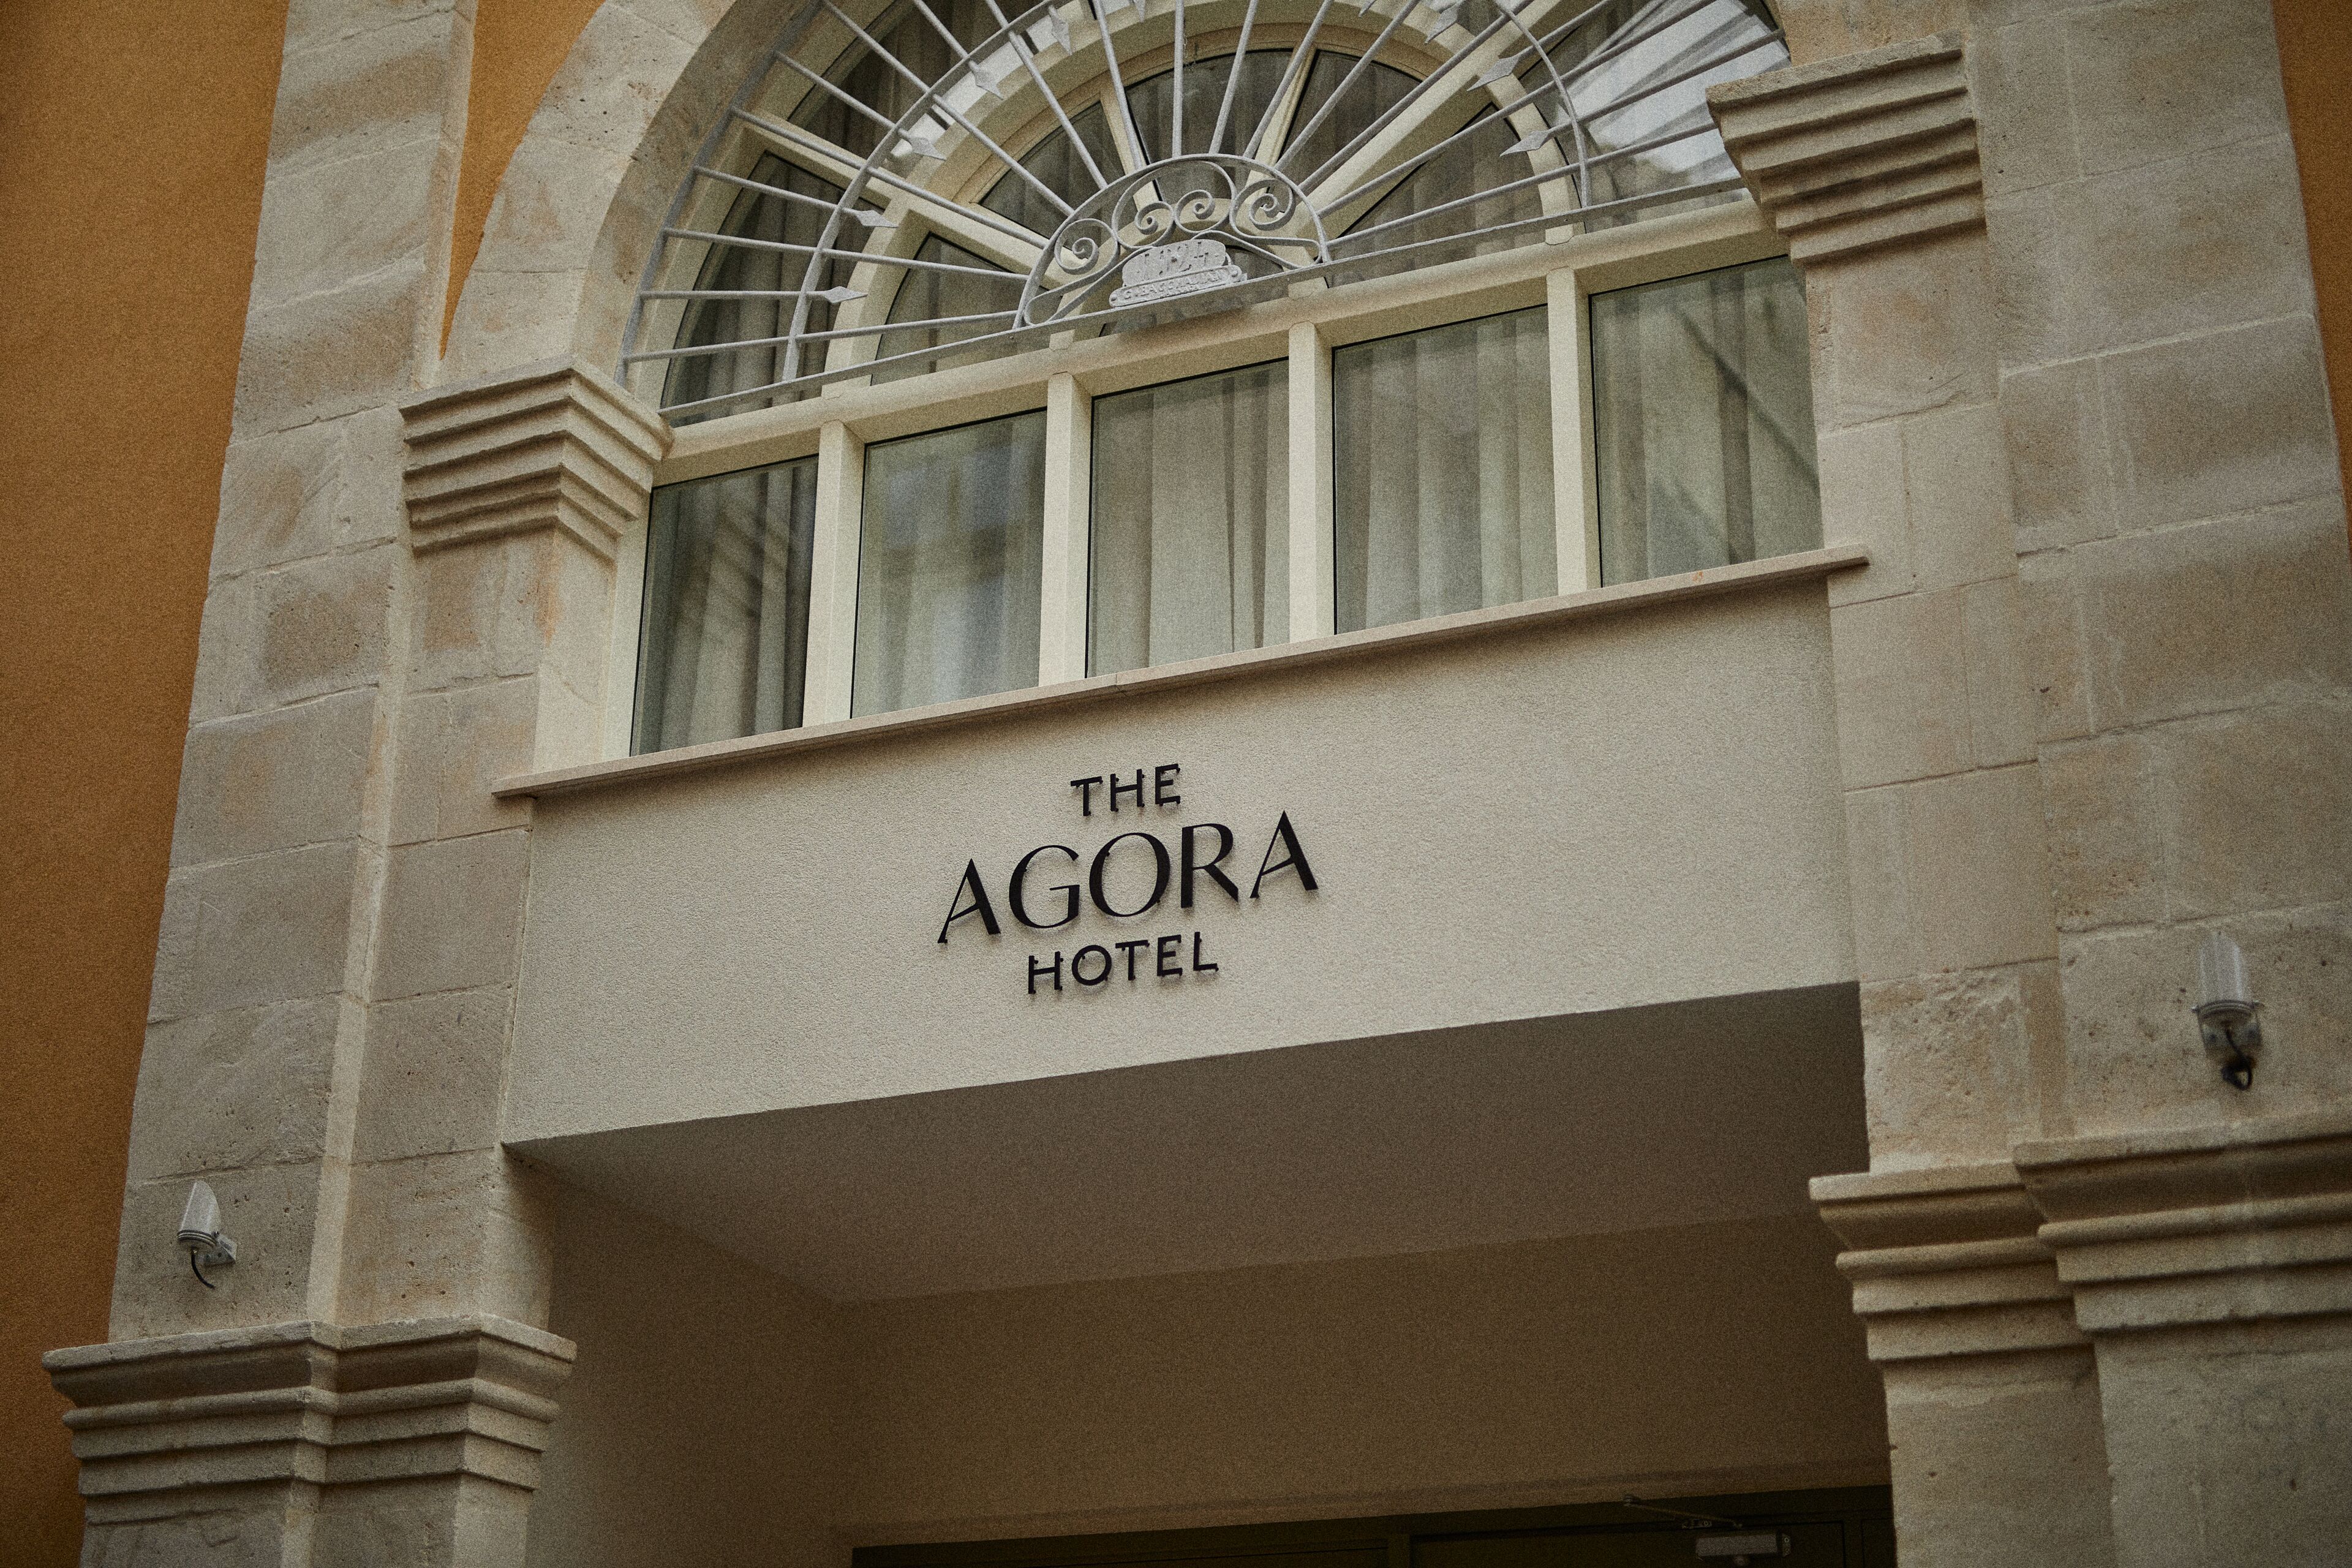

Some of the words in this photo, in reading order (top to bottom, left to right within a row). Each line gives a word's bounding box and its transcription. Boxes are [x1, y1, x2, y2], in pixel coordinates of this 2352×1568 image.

[1070, 763, 1181, 816] THE
[937, 810, 1318, 944] AGORA
[1028, 932, 1219, 995] HOTEL
